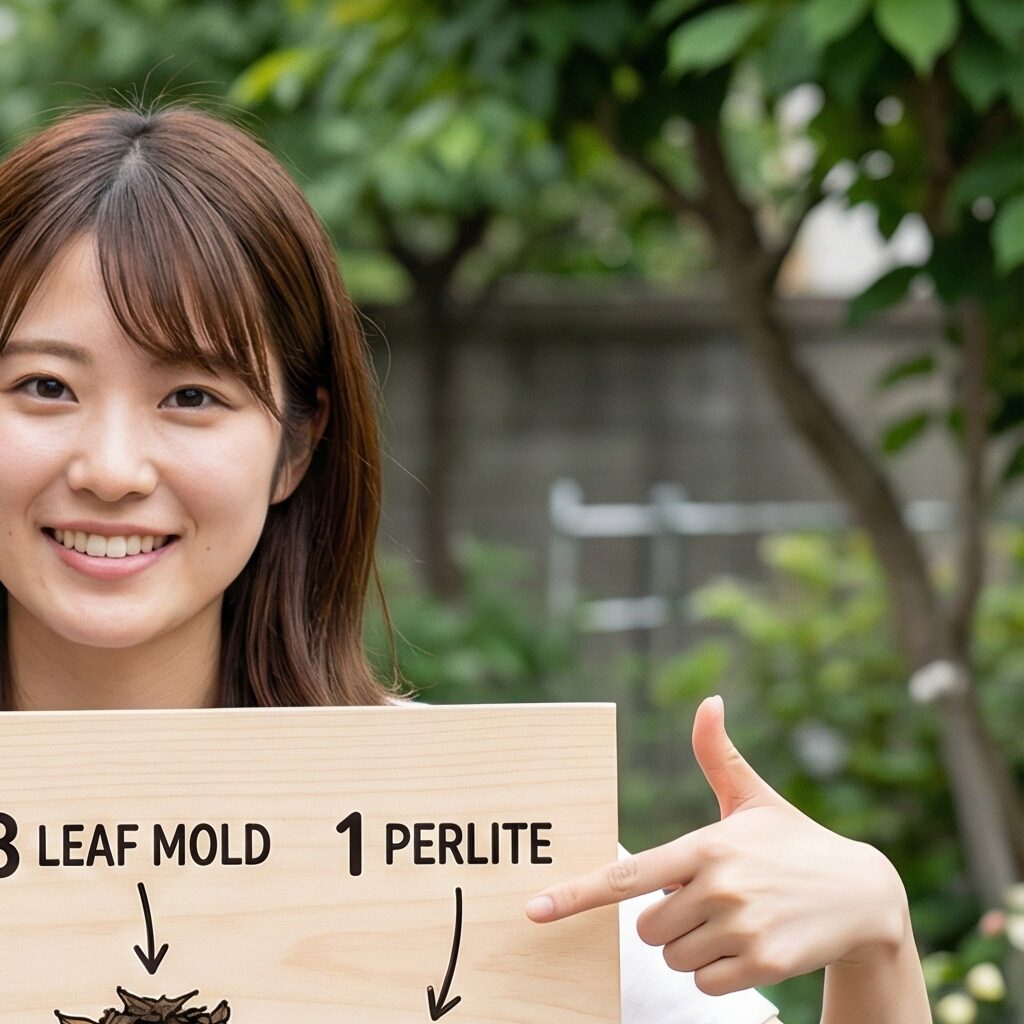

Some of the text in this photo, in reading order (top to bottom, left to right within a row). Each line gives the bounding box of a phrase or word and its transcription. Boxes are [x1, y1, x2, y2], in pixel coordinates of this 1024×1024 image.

[37, 823, 140, 868] LEAF
[152, 822, 272, 868] MOLD
[334, 811, 554, 878] 1 PERLITE
